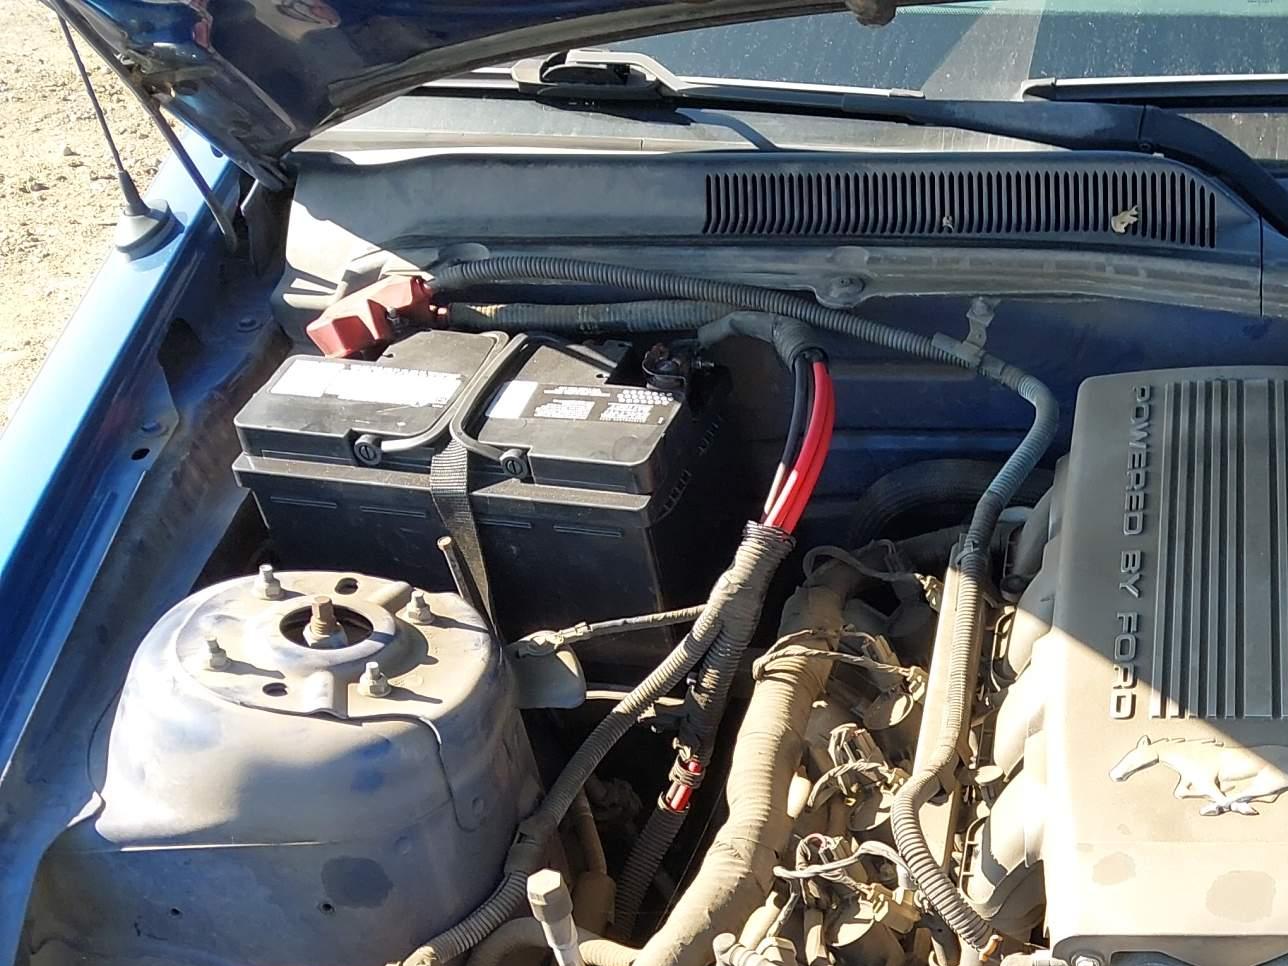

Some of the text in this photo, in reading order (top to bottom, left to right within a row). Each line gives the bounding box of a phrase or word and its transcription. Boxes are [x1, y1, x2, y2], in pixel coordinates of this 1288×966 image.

[1109, 384, 1150, 720] POWERED BY FORD
